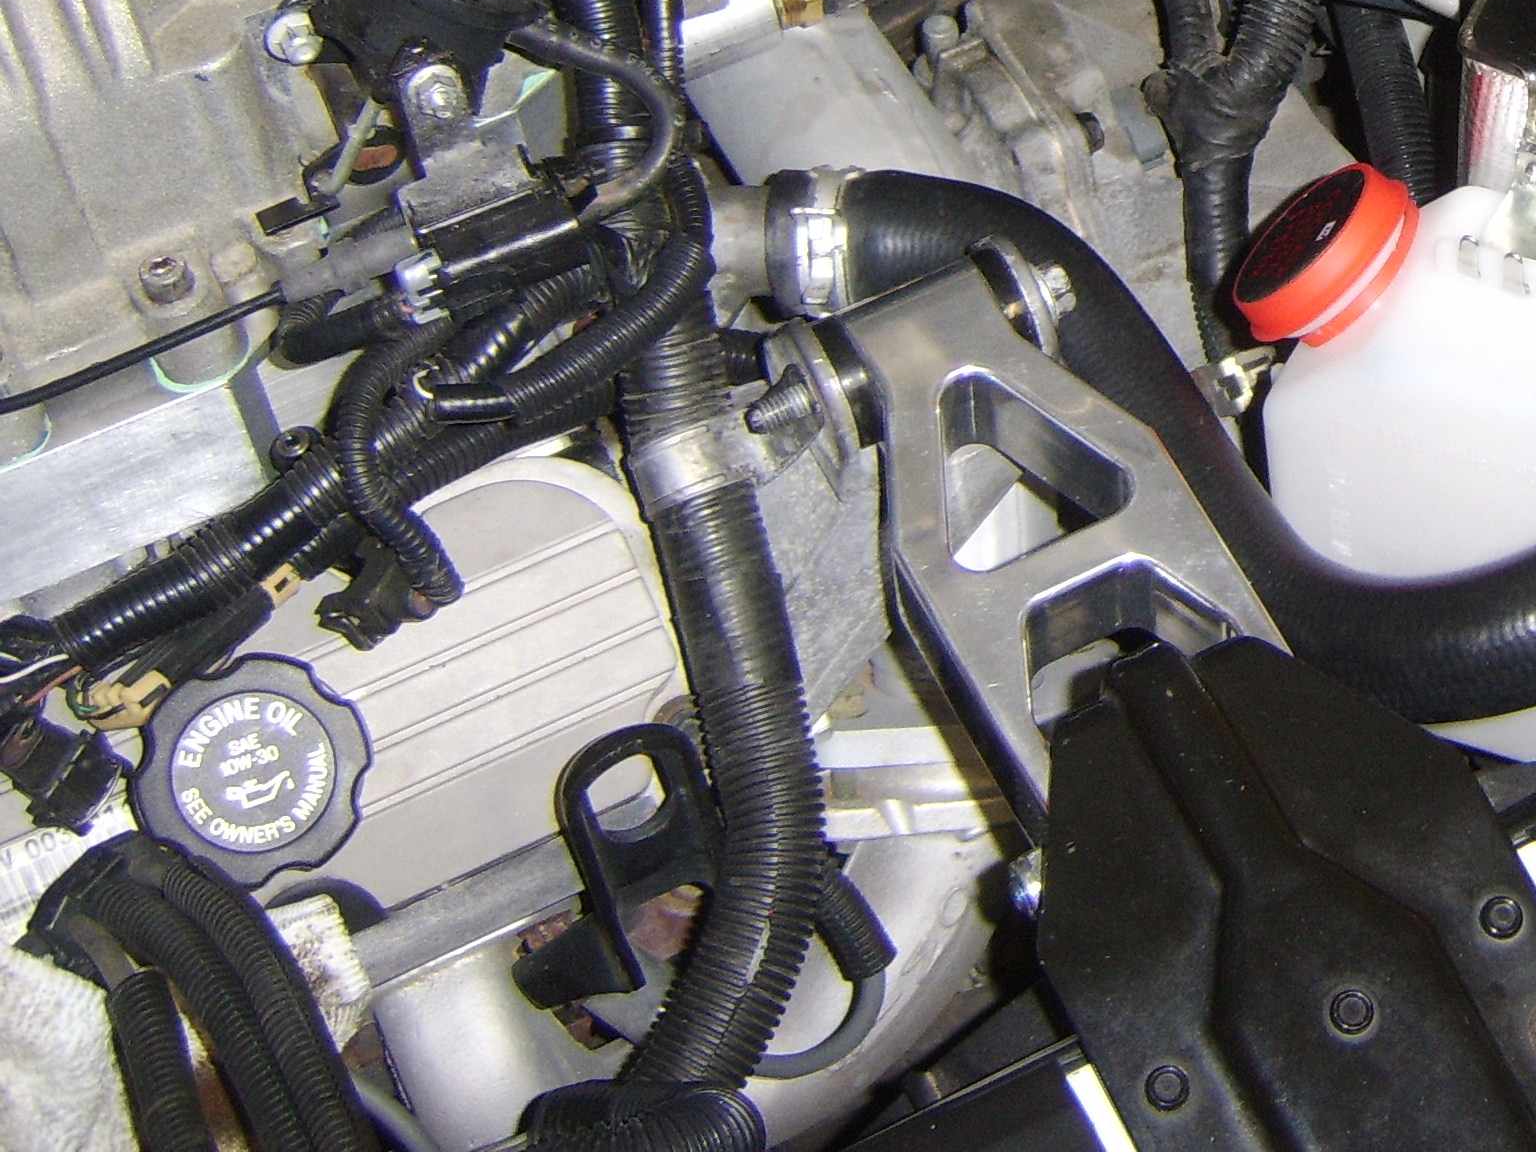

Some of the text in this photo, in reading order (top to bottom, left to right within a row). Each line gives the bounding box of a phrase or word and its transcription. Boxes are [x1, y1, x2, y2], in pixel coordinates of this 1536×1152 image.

[178, 697, 303, 768] ENGINE OIL
[227, 733, 262, 756] SAE
[219, 745, 280, 778] 10W-30
[181, 742, 328, 844] SEE OWNER'S MANUAL
